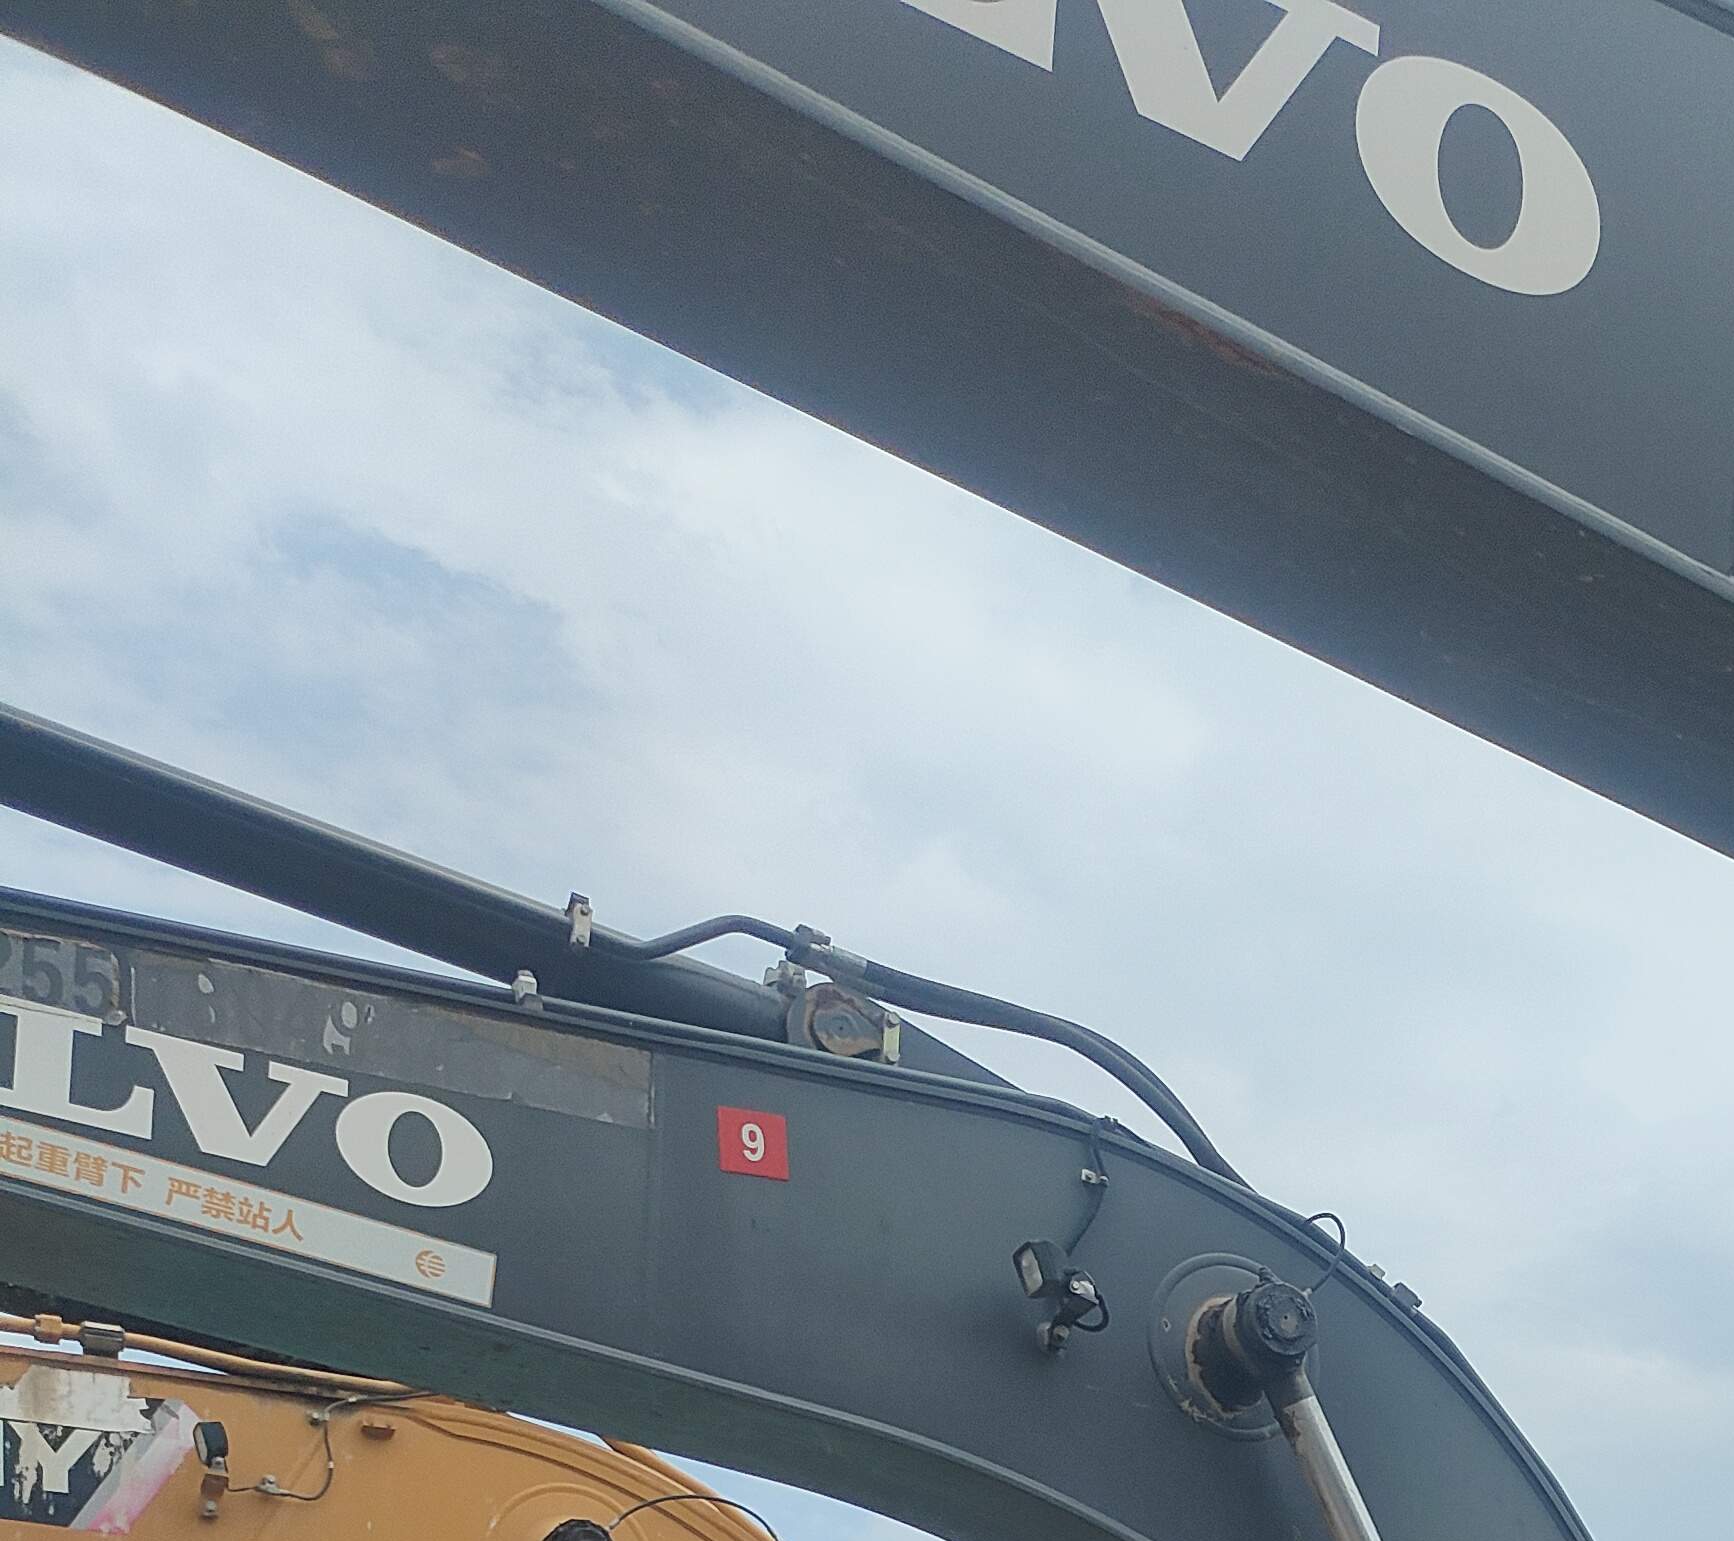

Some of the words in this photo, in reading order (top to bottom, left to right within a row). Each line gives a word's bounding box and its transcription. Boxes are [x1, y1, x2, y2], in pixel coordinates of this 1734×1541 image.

[902, 0, 1601, 296] VO
[0, 932, 112, 1011] 55
[0, 1003, 494, 1207] LVO
[741, 1122, 765, 1162] 9
[0, 1130, 146, 1195] 起重臂下
[164, 1176, 304, 1242] 严禁站人
[0, 1419, 102, 1494] Y
